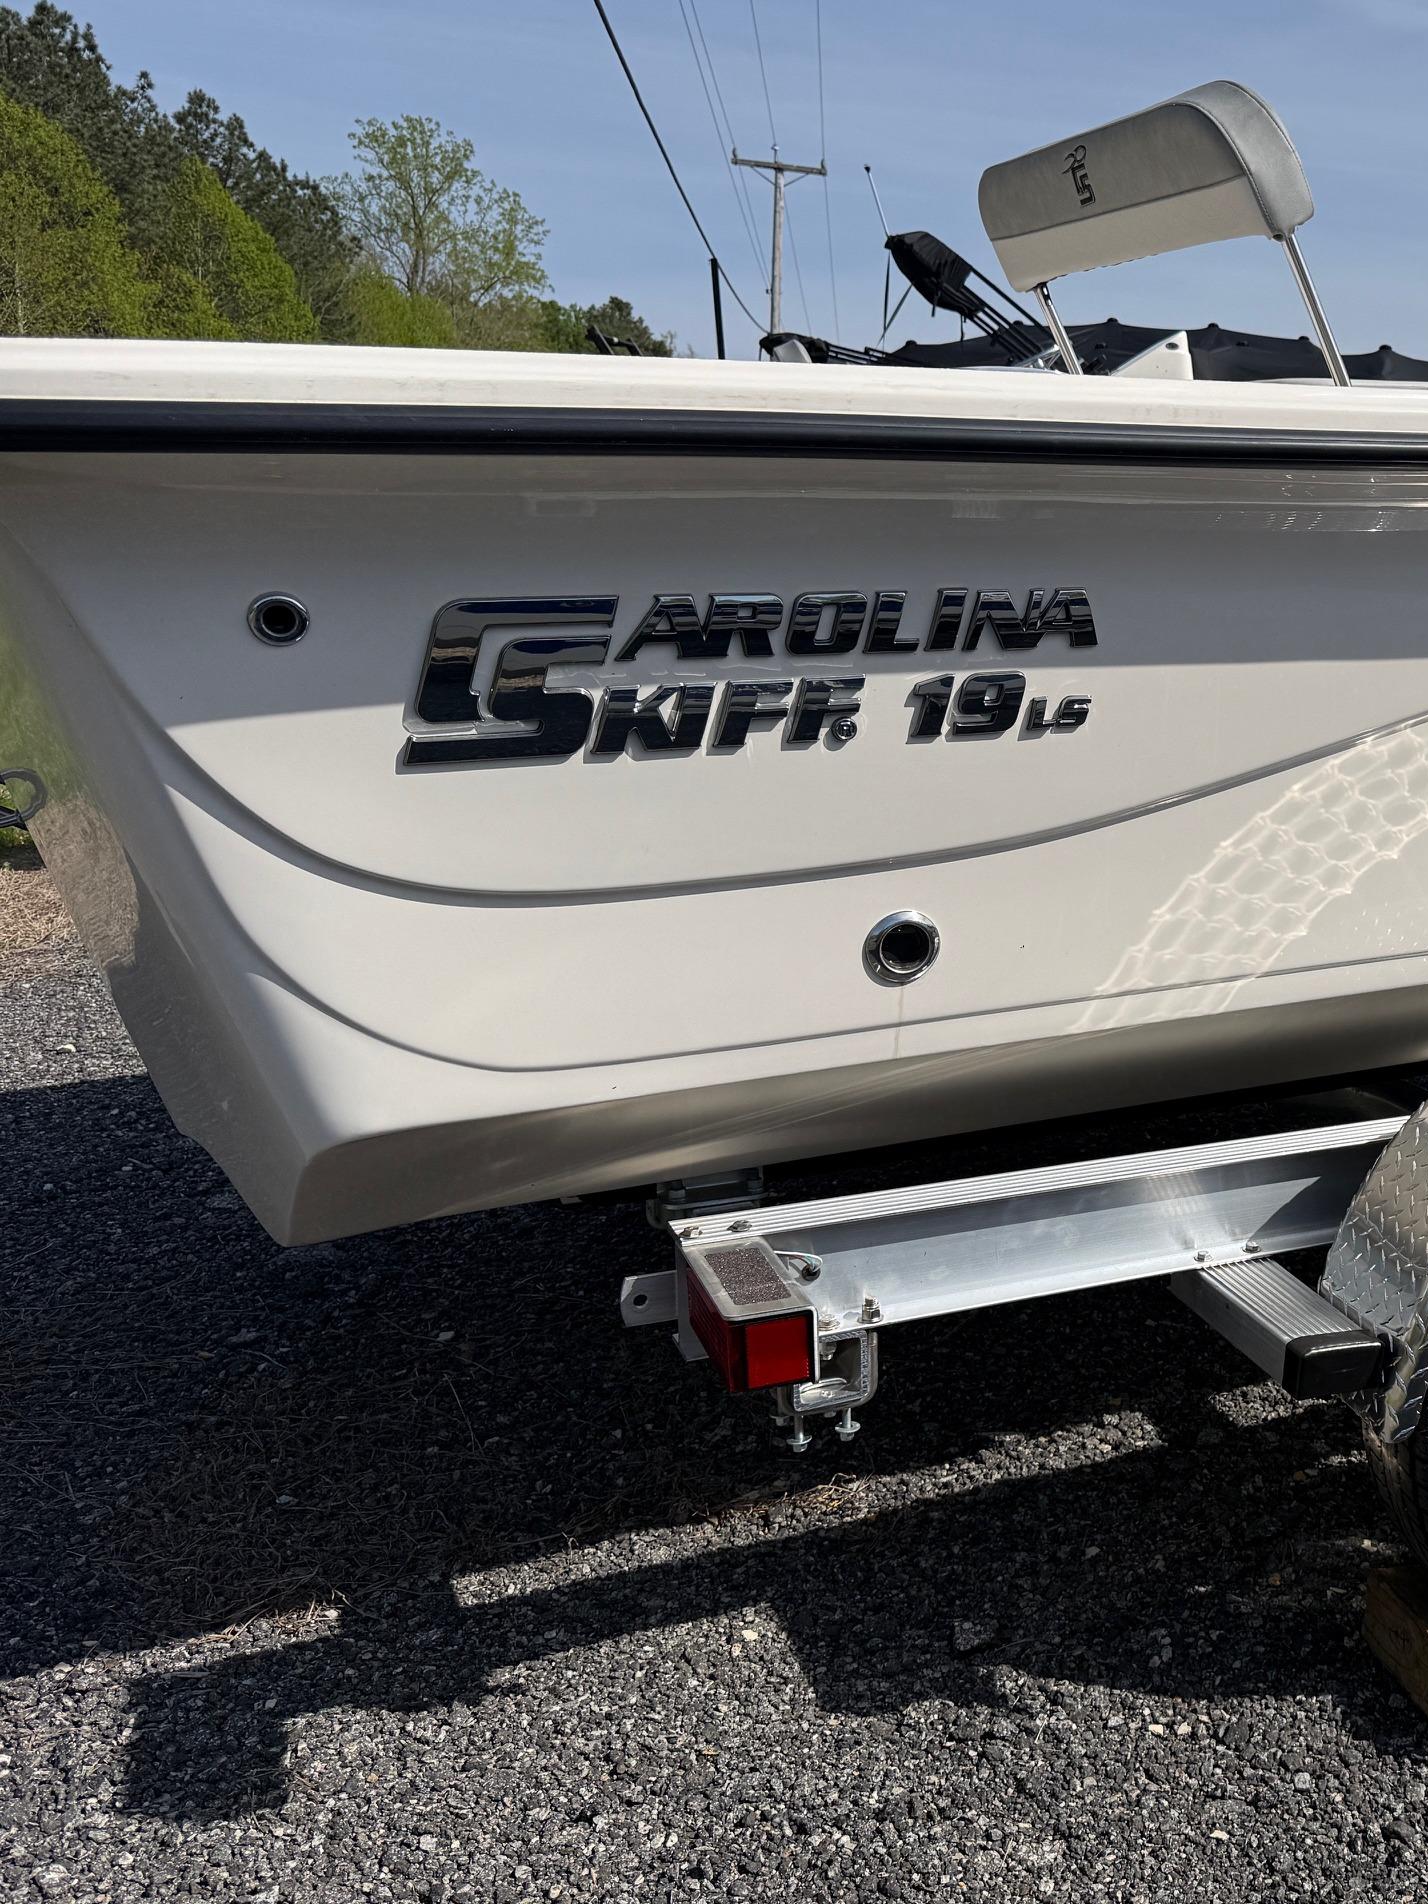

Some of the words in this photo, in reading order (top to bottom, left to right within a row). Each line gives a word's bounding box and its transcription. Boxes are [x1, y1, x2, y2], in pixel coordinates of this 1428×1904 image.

[402, 586, 1100, 732] CAROLINA
[911, 671, 1026, 737] 19
[1027, 695, 1092, 732] LS
